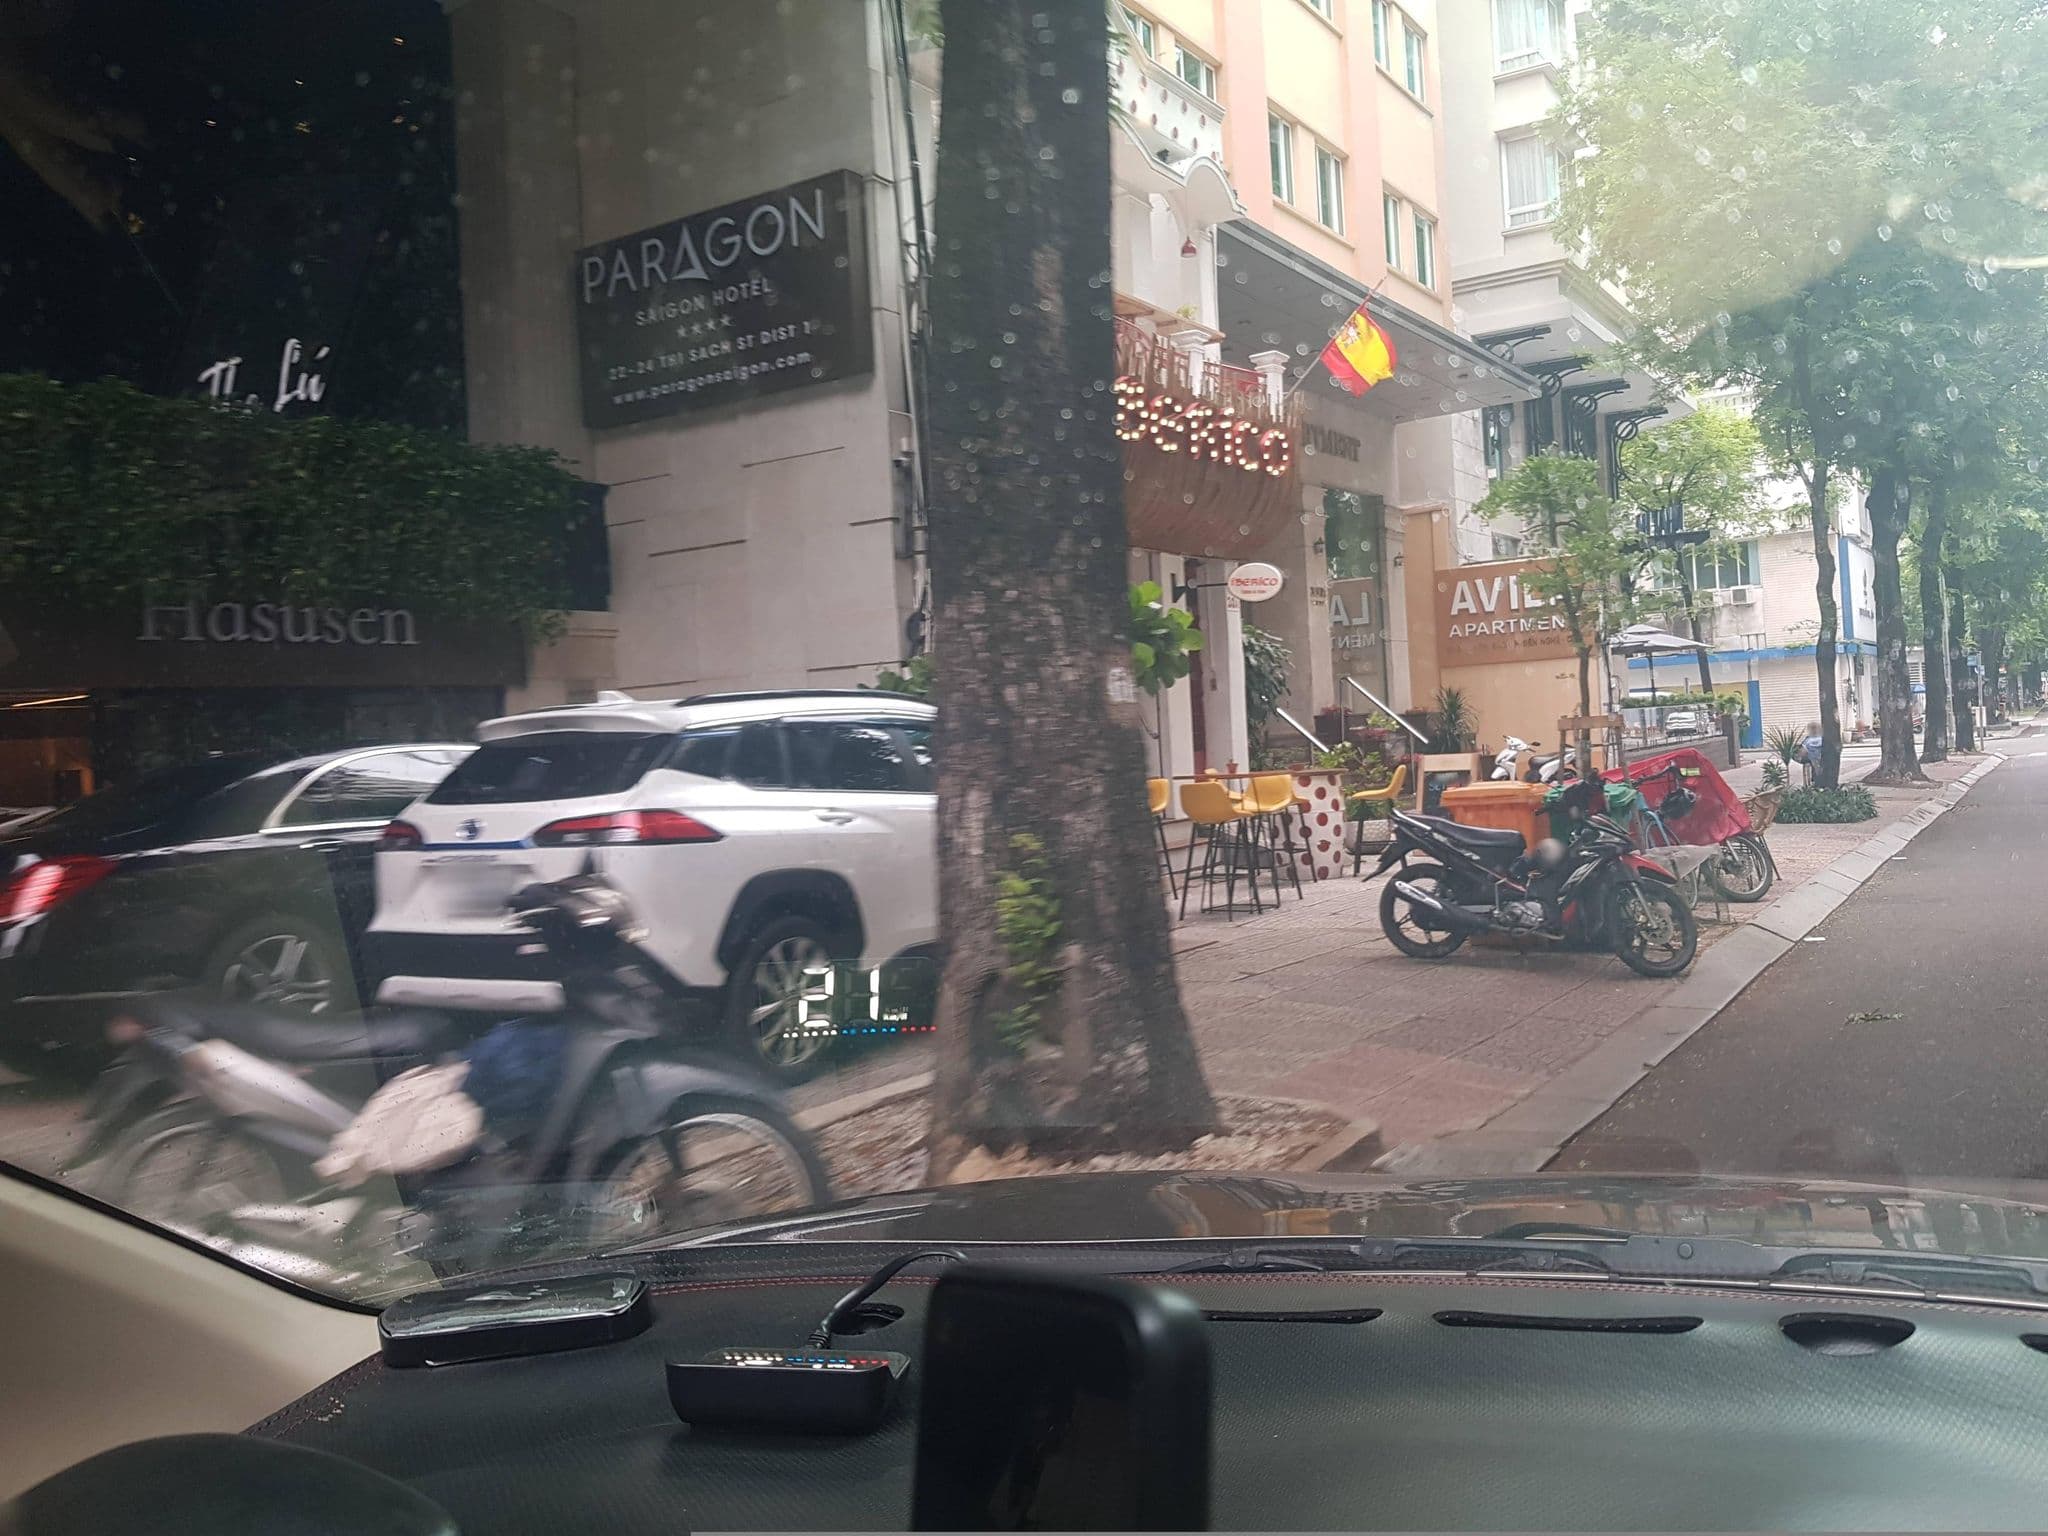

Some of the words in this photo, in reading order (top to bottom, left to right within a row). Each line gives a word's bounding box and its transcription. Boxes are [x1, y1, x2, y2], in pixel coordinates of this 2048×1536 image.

[582, 188, 825, 303] PARAGON
[636, 294, 705, 326] SAIGON
[712, 276, 773, 307] HOTEL
[736, 334, 754, 350] ST
[760, 323, 797, 345] DIST
[136, 588, 421, 645] Hasusen
[798, 967, 880, 1027] 21
